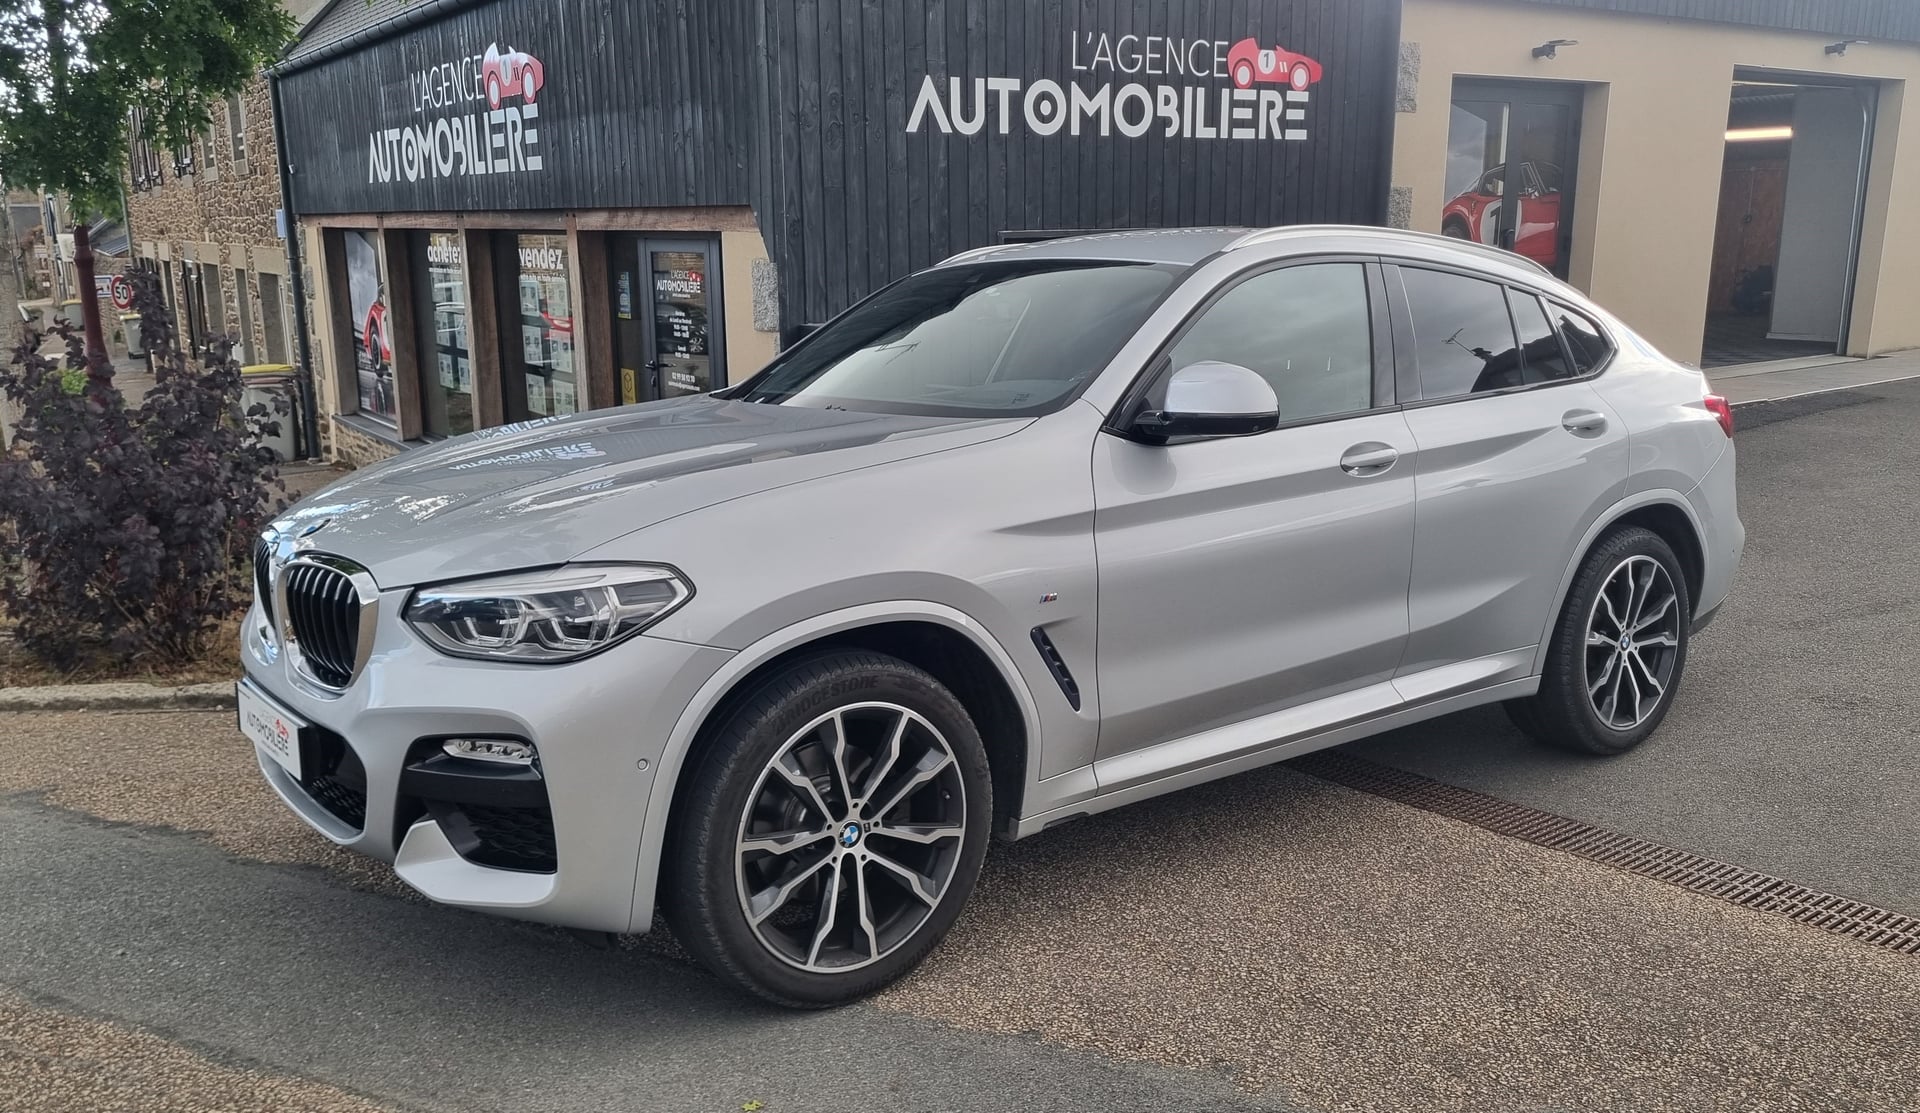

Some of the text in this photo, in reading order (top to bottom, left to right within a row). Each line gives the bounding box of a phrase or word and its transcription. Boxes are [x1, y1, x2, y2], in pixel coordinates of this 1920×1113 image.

[1071, 30, 1229, 78] L'AGENCE
[411, 54, 486, 113] L'AGENCE
[905, 74, 1309, 140] AUTOMOBILIERE
[368, 102, 543, 184] AUTOMOBILIERE
[518, 236, 564, 270] vendez
[115, 285, 128, 300] 50
